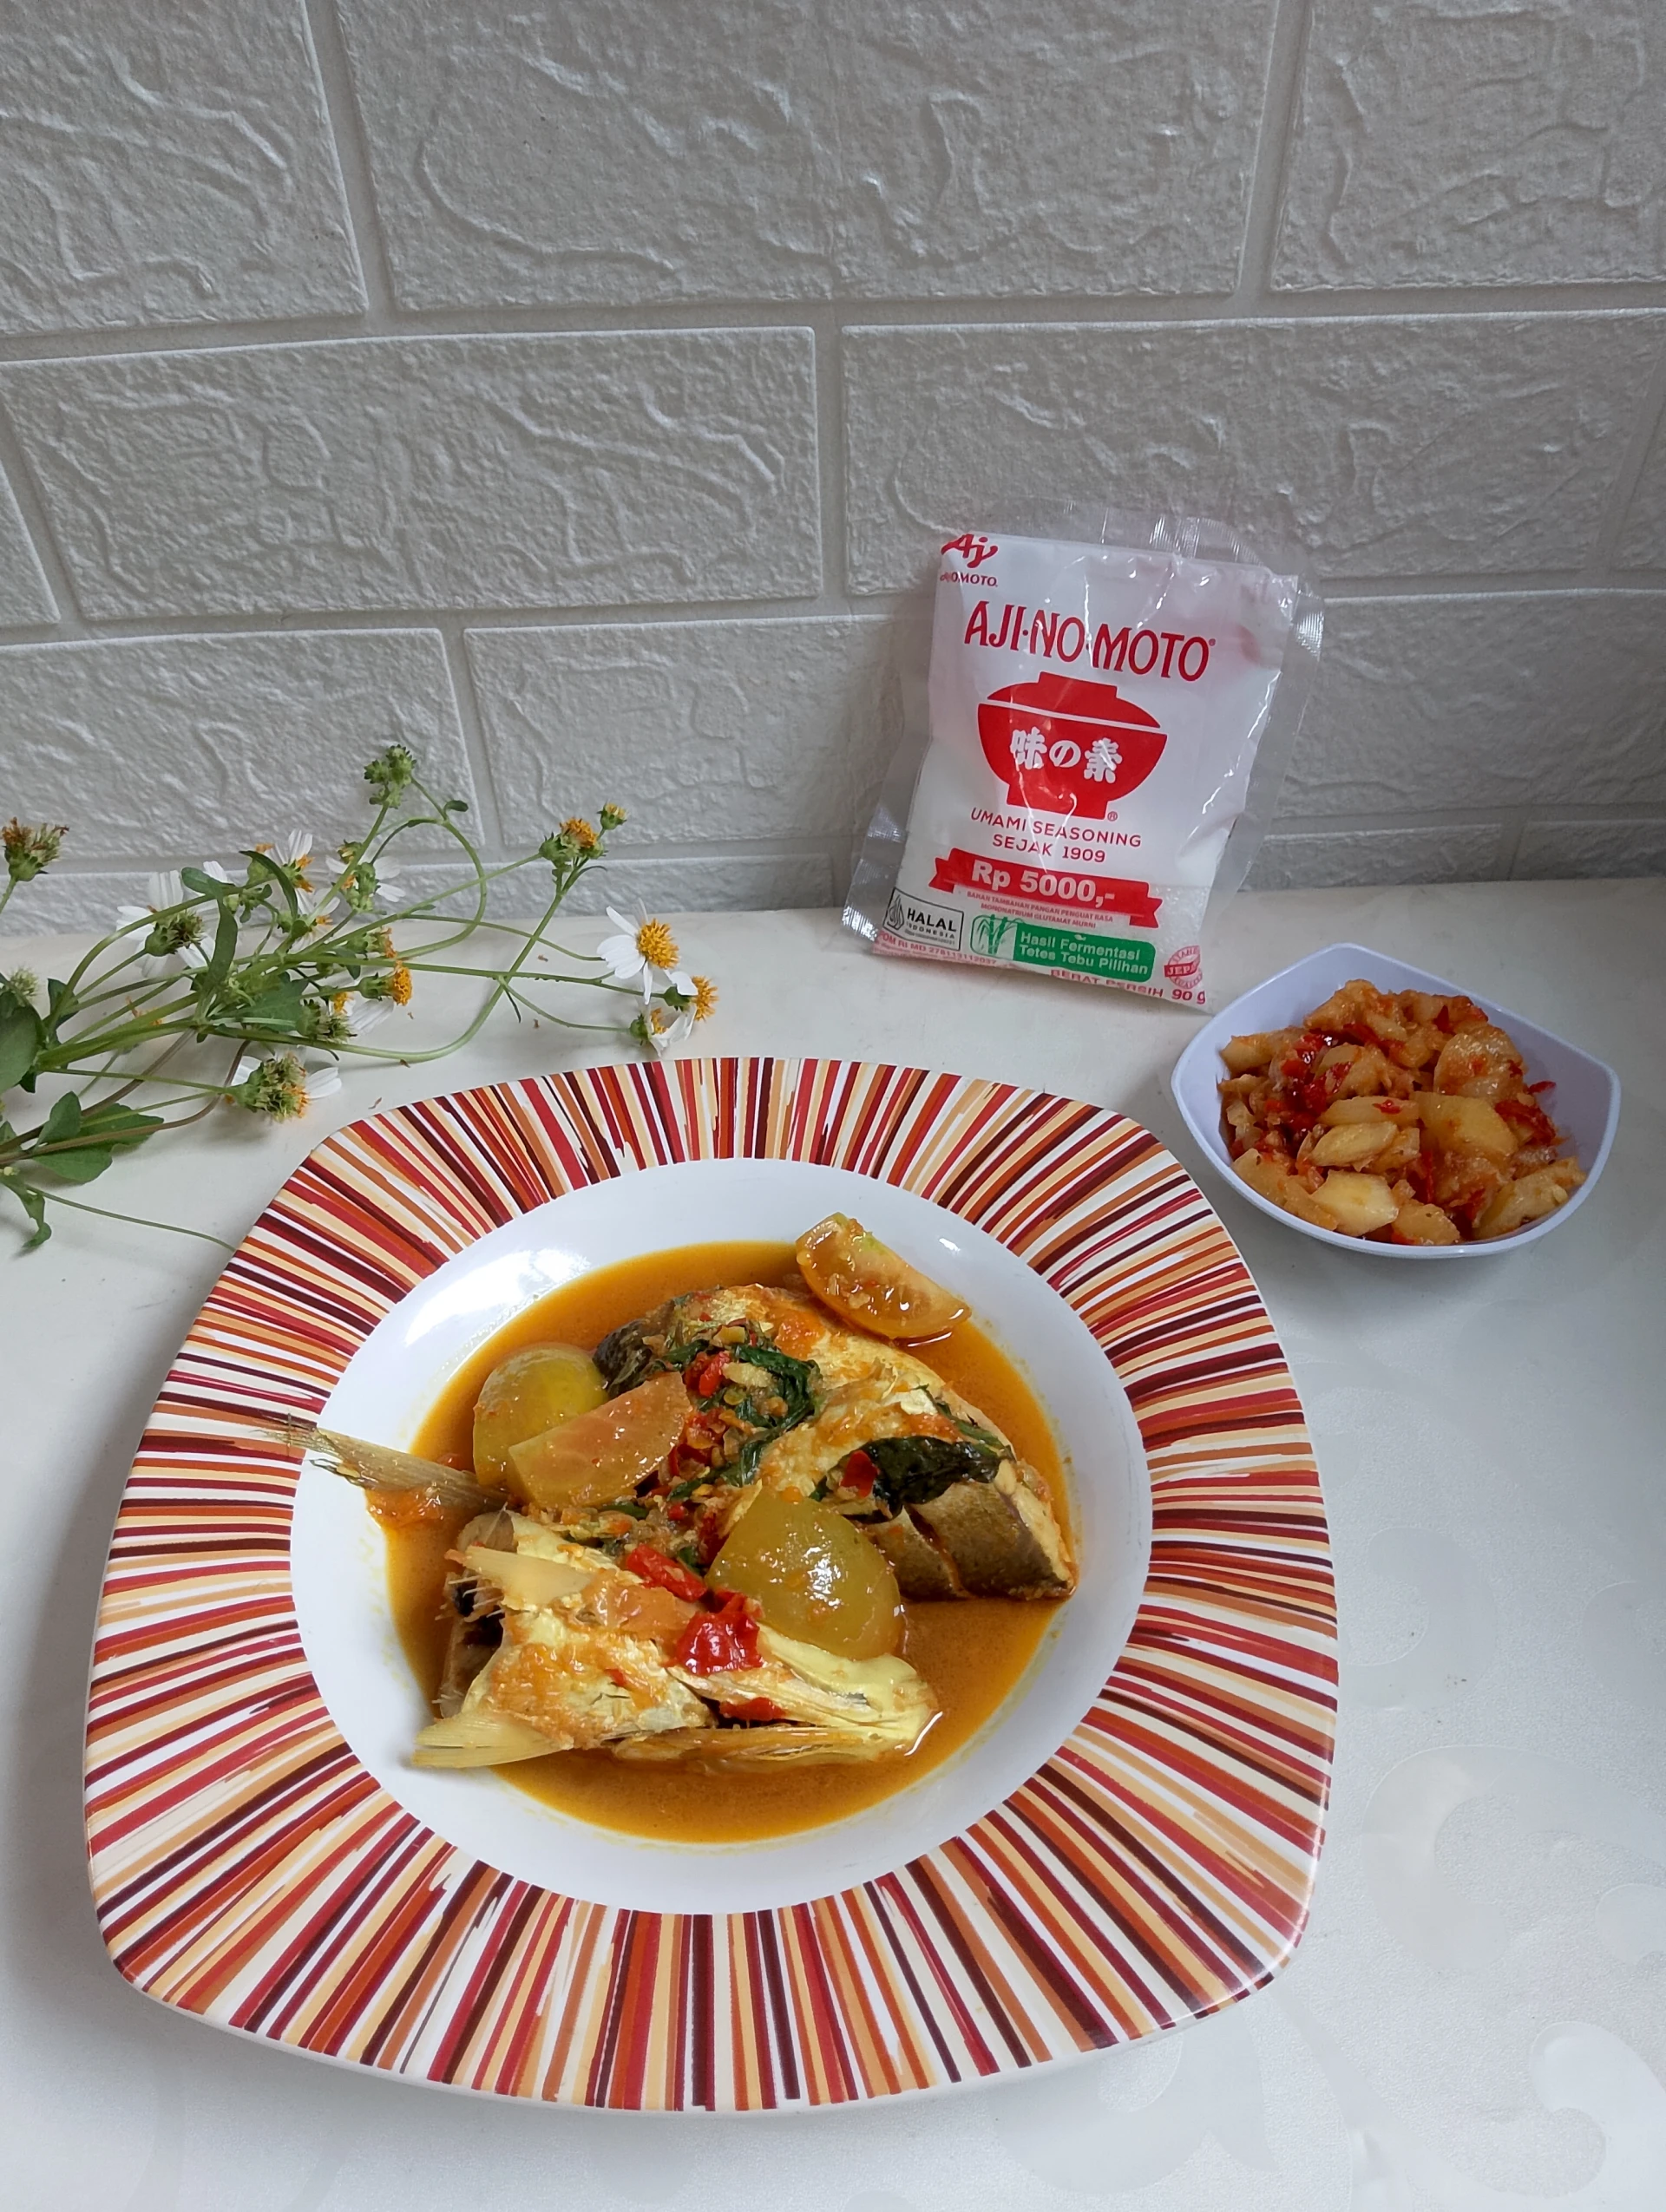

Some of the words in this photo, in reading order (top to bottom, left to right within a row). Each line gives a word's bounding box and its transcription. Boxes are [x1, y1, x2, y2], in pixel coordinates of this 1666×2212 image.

[1010, 726, 1123, 784] 味の素
[970, 807, 1026, 832] UMAMI
[1033, 821, 1142, 847] SEASONING
[992, 834, 1053, 857] SEJAK
[1062, 846, 1106, 863] 1909
[971, 860, 1011, 891] Rp
[1020, 870, 1116, 908] 5000,-
[907, 907, 957, 933] HALAL
[967, 891, 991, 902] BAHAN
[992, 894, 1030, 909] TAMBAHAN
[1030, 904, 1061, 915] PANGAN
[1061, 910, 1094, 920] PENGUAT
[981, 903, 1033, 918] MONONATRIUM
[1033, 913, 1071, 925] GLUTAMAT
[1072, 920, 1096, 929] MURNI
[906, 921, 955, 939] INDONESIA
[910, 943, 927, 952] MD
[1020, 932, 1056, 948] Hasil
[1060, 939, 1140, 960] Fermentasi
[1020, 944, 1056, 960] Tetes
[1061, 952, 1094, 968] Tebu
[1099, 959, 1148, 975] Pilihan
[1051, 969, 1100, 985] BERAT
[1171, 989, 1192, 1000] 90
[1197, 991, 1205, 1005] g
